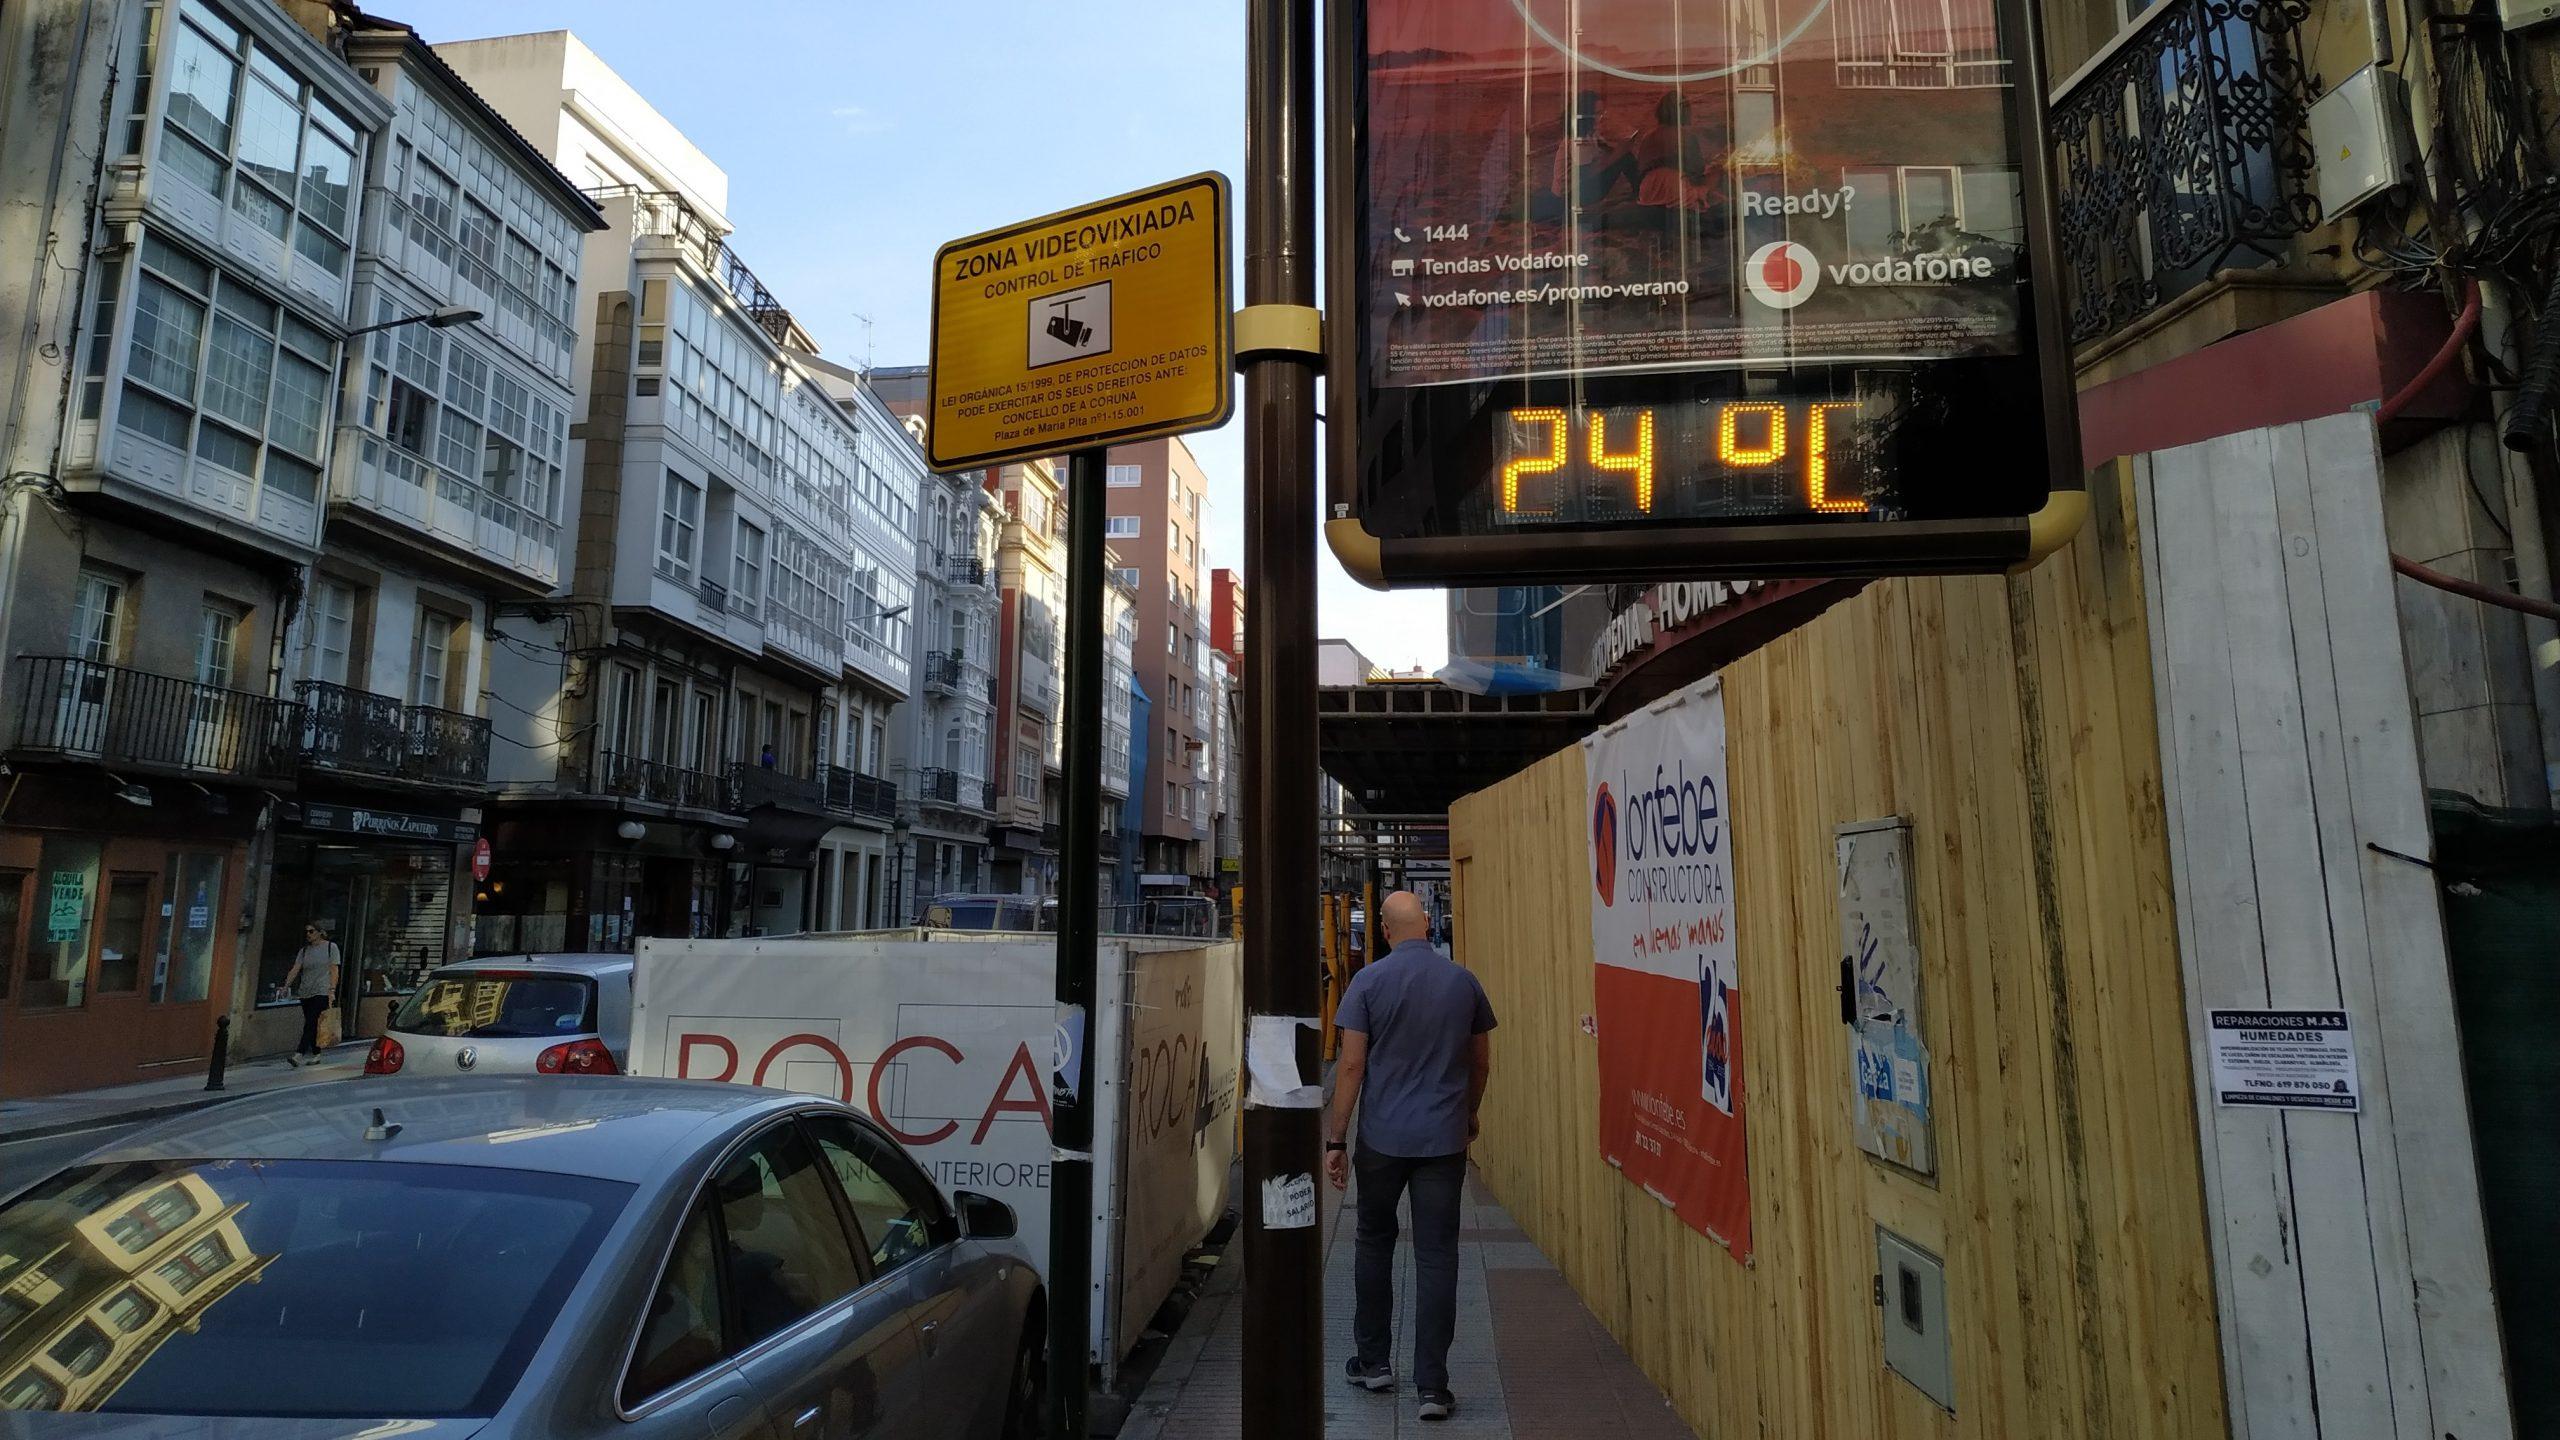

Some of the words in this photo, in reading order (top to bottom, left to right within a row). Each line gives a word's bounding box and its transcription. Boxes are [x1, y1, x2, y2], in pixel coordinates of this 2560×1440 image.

[1743, 186, 1855, 219] Ready?
[955, 247, 1018, 281] ZONA
[1025, 200, 1195, 262] VIDEOVIXIADA
[1423, 224, 1470, 242] 1444
[985, 270, 1058, 299] CONTROL
[1064, 263, 1084, 281] DE
[1091, 243, 1161, 274] TRÁFICO
[1422, 256, 1490, 276] Tendas
[1495, 252, 1589, 272] Vodafone
[1828, 254, 1992, 284] vodafone
[1422, 279, 1690, 308] vodafone.es/promo-verano
[942, 396, 956, 408] LEI
[959, 384, 1012, 405] ORGÁNICA
[1059, 373, 1074, 386] DE
[1151, 354, 1166, 367] DE
[1169, 344, 1207, 362] DATOS
[958, 404, 985, 419] PODE
[988, 393, 1044, 414] EXERCITAR
[1047, 389, 1062, 401] OS
[1066, 383, 1093, 399] SEUS
[1097, 372, 1151, 393] DEREITOS
[1003, 405, 1058, 425] CONCELLO
[1062, 402, 1077, 415] DE
[1079, 399, 1088, 411] A
[994, 427, 1020, 442] Plaza
[1023, 424, 1036, 437] de
[1068, 414, 1088, 430] Pita
[1504, 408, 1653, 514] 24
[53, 872, 84, 885] ALQUILA
[53, 886, 84, 900] VENDE
[2216, 1016, 2304, 1027] REPARACIONES
[2307, 1016, 2345, 1027] M.A.S.
[2240, 1031, 2324, 1042] HUMEDADES
[2244, 1080, 2275, 1088] TLFNO:
[1289, 1187, 1312, 1201] PODER
[1287, 1200, 1315, 1217] SALARIO
